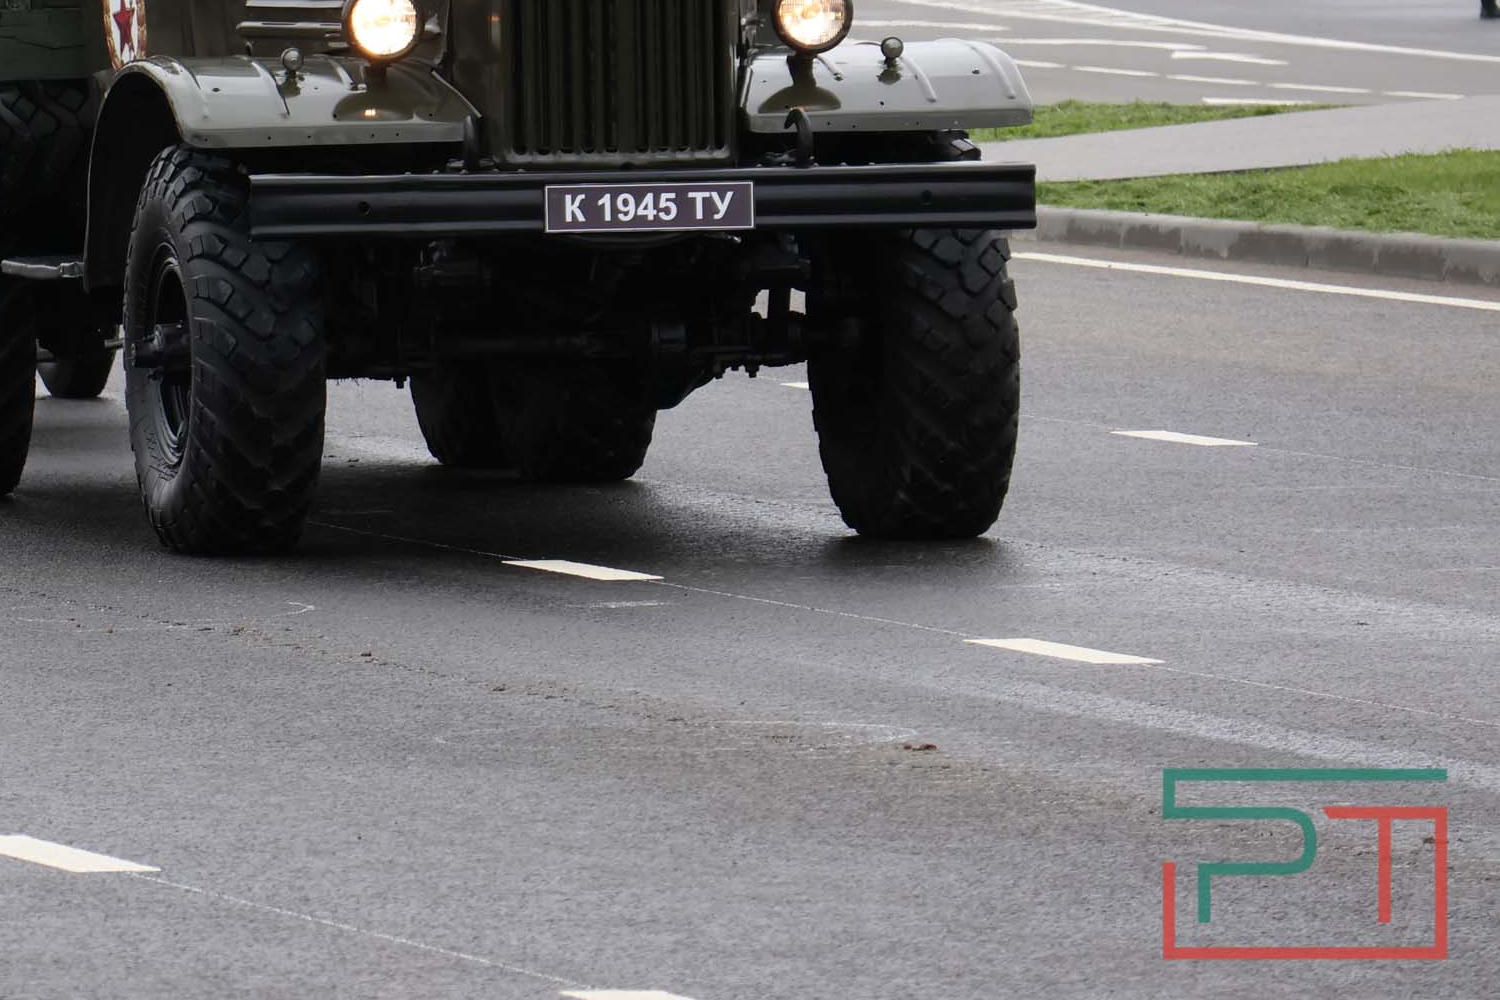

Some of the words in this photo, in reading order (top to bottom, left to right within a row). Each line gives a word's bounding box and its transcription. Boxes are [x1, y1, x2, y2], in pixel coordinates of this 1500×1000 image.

[564, 194, 586, 222] К
[597, 192, 677, 222] 1945
[687, 191, 734, 220] ТУ
